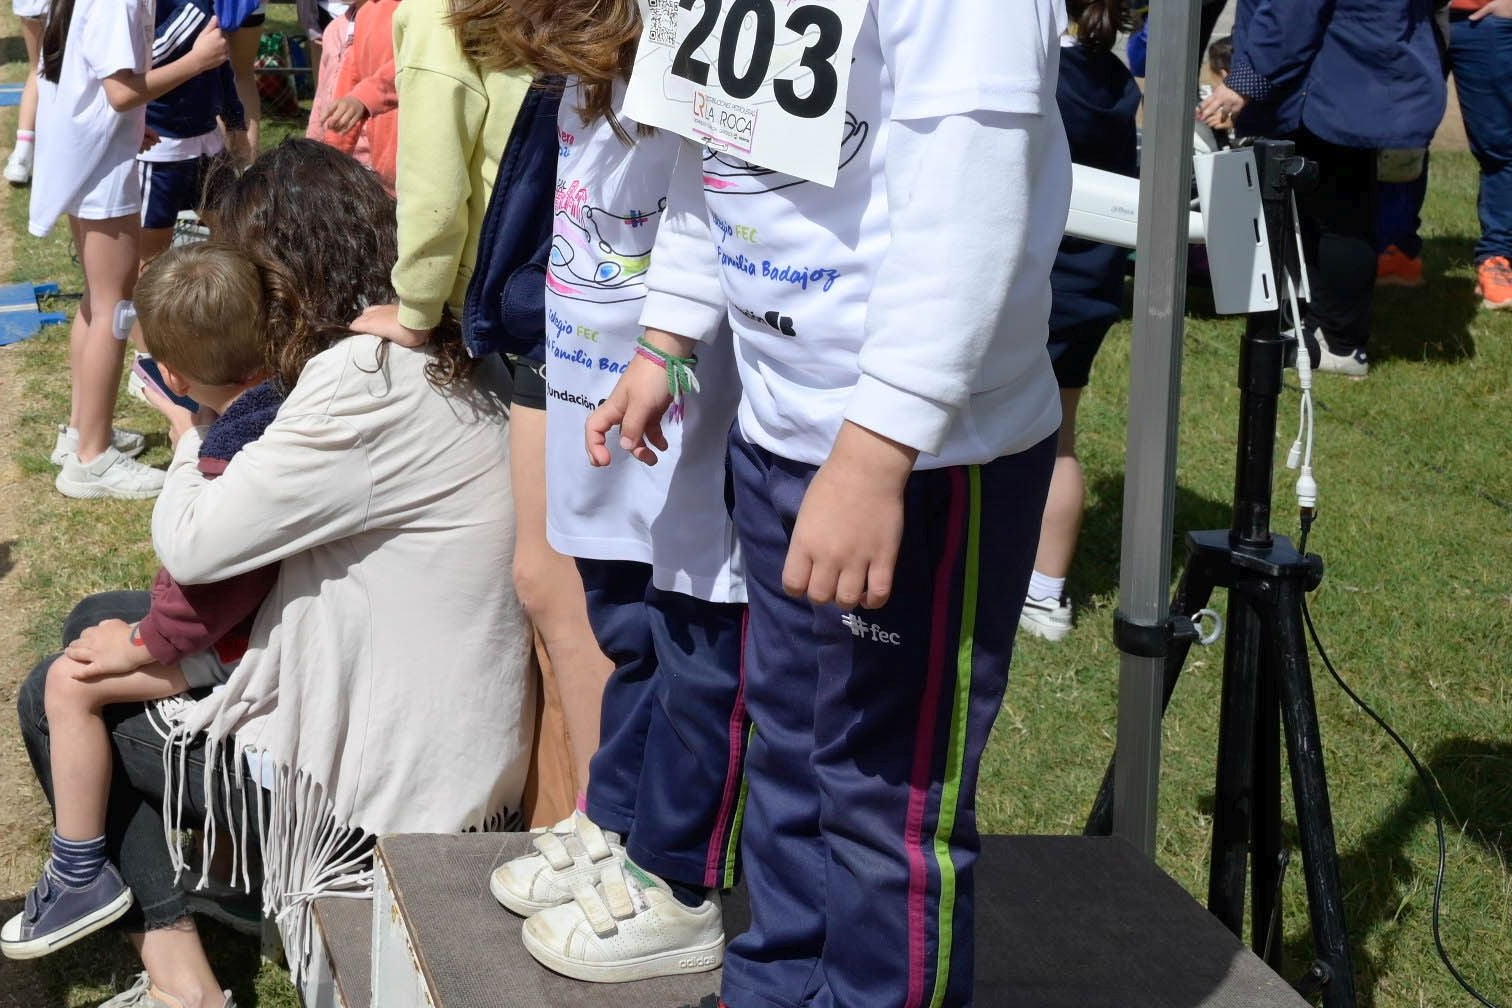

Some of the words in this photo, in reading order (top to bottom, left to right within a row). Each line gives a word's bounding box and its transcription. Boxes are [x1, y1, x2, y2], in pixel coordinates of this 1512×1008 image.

[719, 110, 752, 137] ROCA
[735, 224, 759, 244] FEC
[717, 245, 756, 276] Familia
[761, 260, 841, 293] Badajoz
[576, 324, 600, 343] FEC
[551, 339, 593, 369] Familia
[679, 955, 717, 969] adidas
